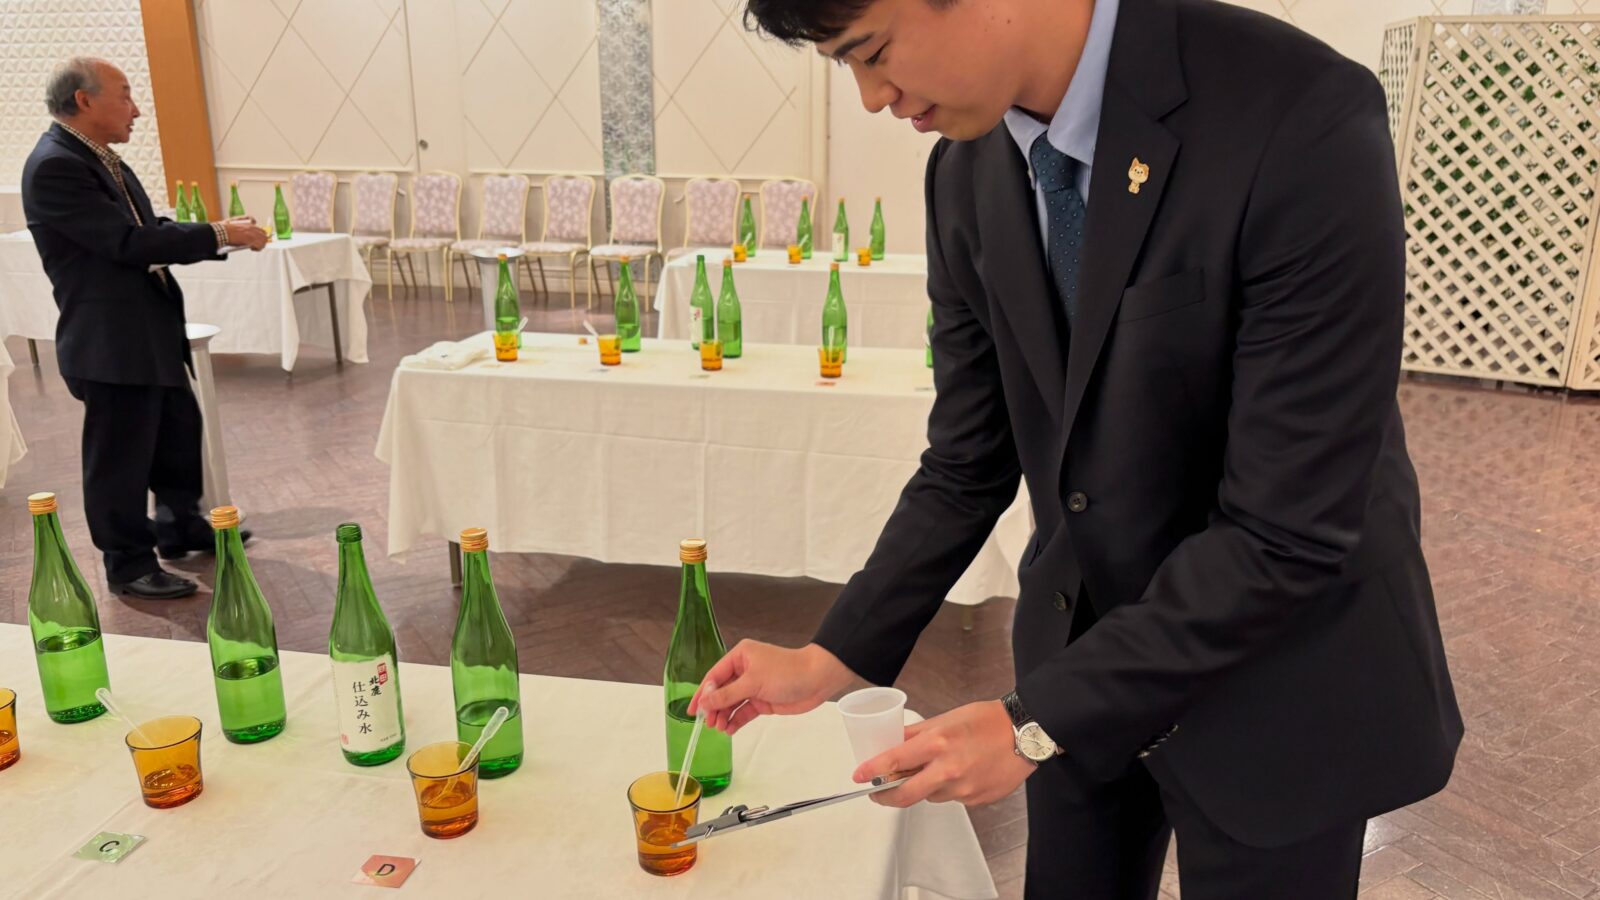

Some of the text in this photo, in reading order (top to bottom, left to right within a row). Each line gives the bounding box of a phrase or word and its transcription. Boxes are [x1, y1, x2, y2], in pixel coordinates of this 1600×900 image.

[352, 681, 373, 734] 仕込み水
[99, 840, 120, 853] C
[375, 863, 395, 876] D
